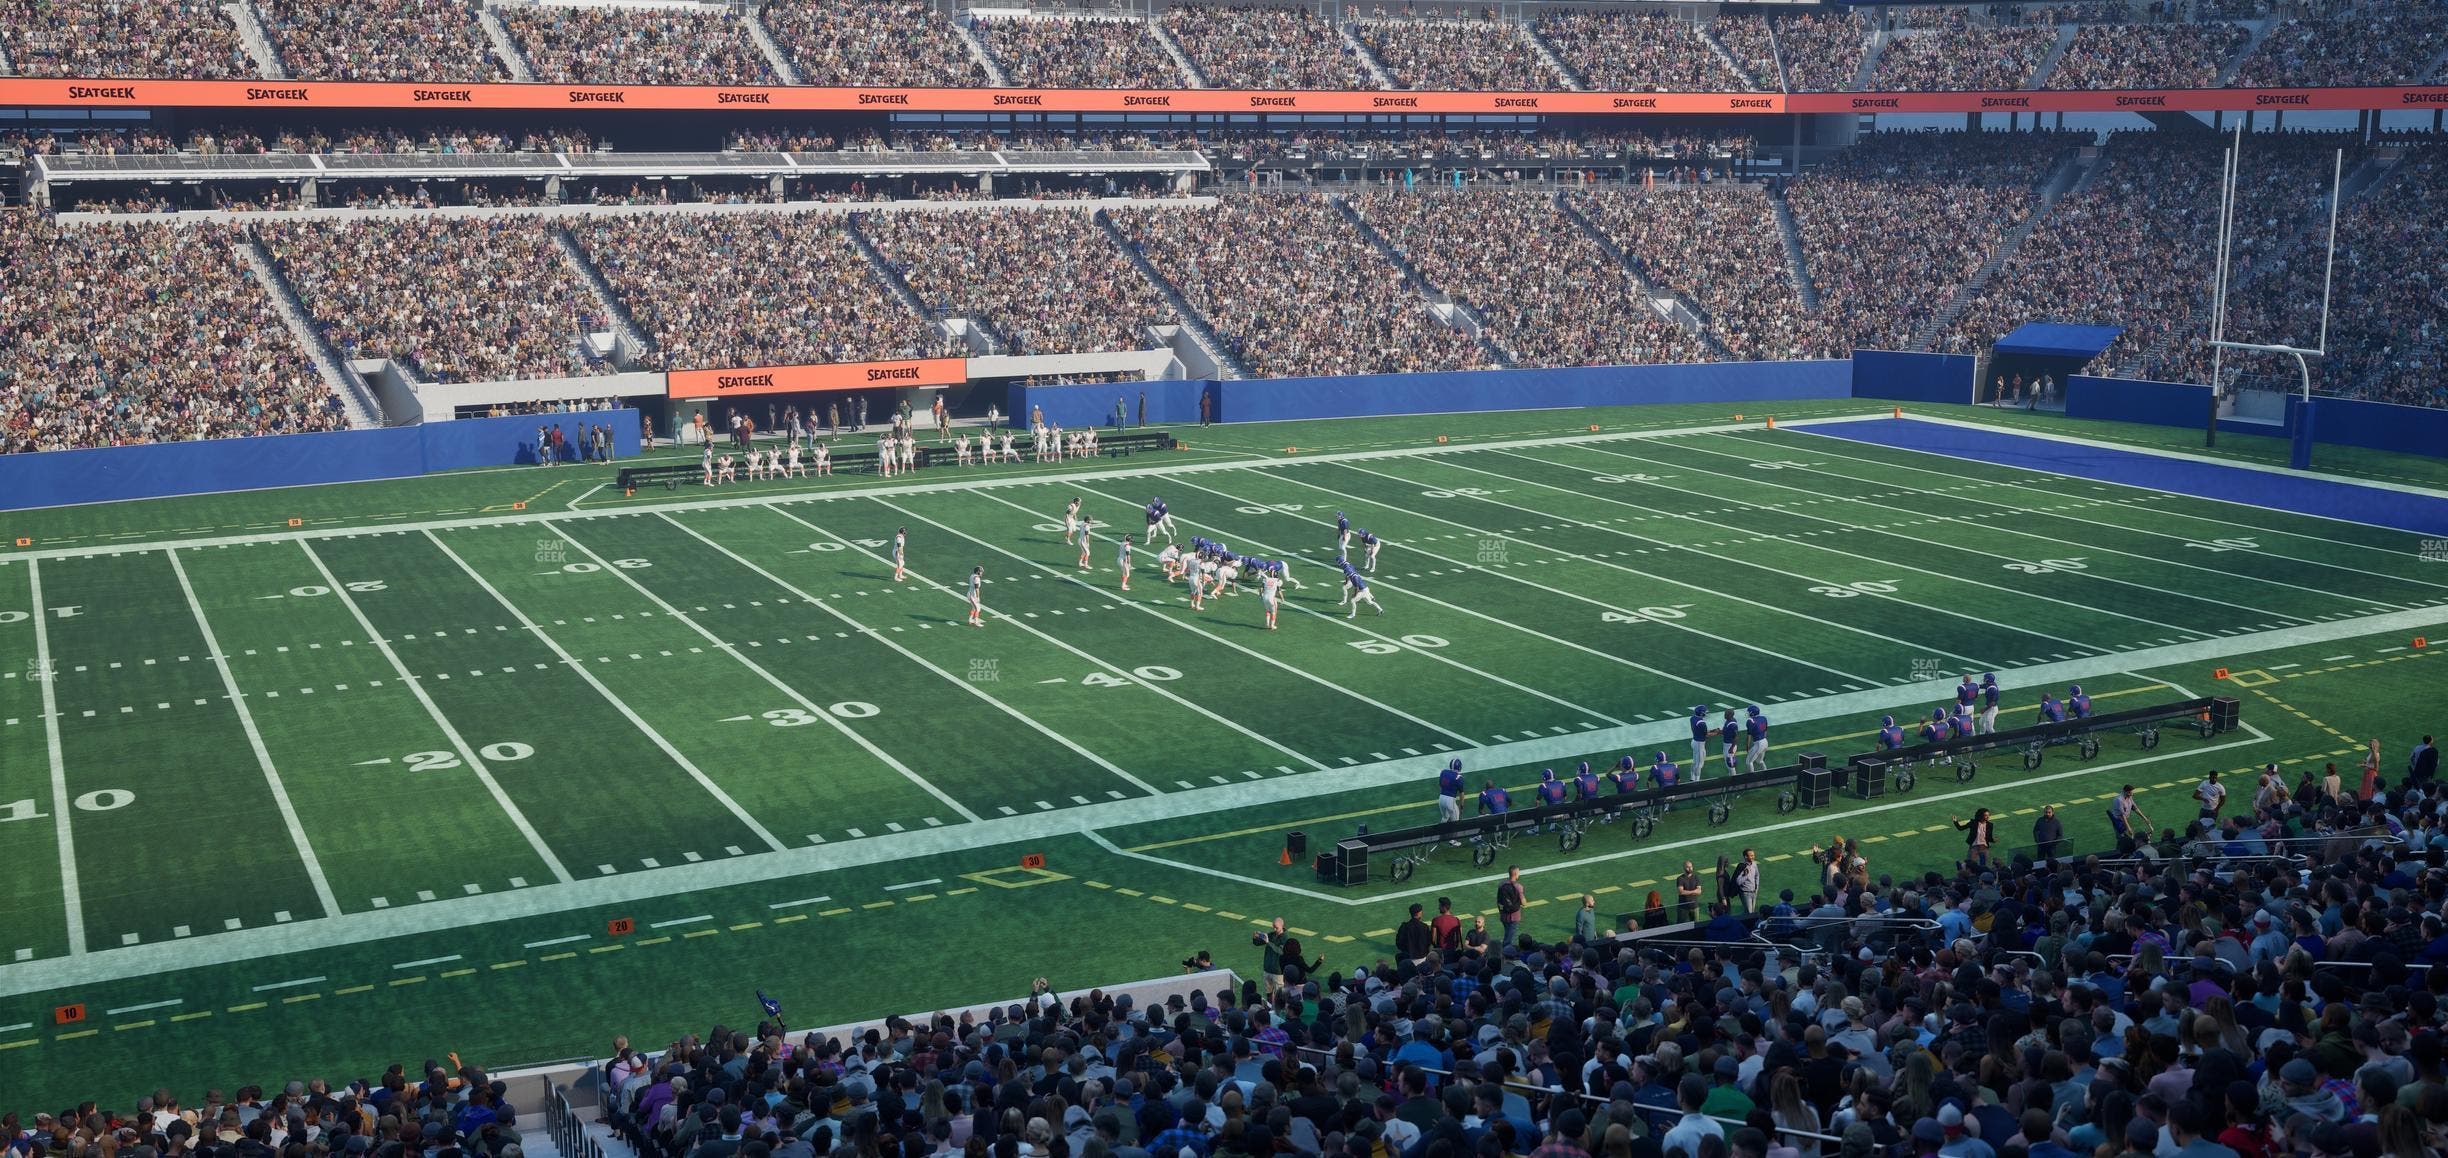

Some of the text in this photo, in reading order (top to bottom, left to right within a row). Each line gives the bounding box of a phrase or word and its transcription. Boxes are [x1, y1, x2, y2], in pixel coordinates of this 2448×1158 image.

[69, 86, 135, 100] SEATGEEK
[247, 88, 308, 101] SEATGEEK
[414, 89, 471, 102] SEATGEEK
[570, 91, 624, 103] SEATGEEK
[718, 92, 769, 104] SEATGEEK
[859, 93, 908, 105] SEATGEEK
[994, 94, 1042, 106] SEATGEEK
[1124, 95, 1170, 107] SEATGEEK
[1251, 96, 1295, 107] SEATGEEK
[1374, 97, 1417, 108] SEATGEEK
[1495, 97, 1537, 108] SEATGEEK
[1614, 98, 1656, 109] SEATGEEK
[1731, 98, 1771, 109] SEATGEEK
[1852, 98, 1898, 108] SEATGEEK
[1980, 97, 2029, 107] SEATGEEK
[2116, 96, 2165, 106] SEATGEEK
[2256, 94, 2309, 105] SEATGEEK
[868, 367, 919, 382] SEATGEEK
[718, 374, 773, 389] SEATGEEK
[1029, 857, 1040, 866] 30
[615, 921, 627, 931] 20
[63, 1007, 77, 1019] 10
